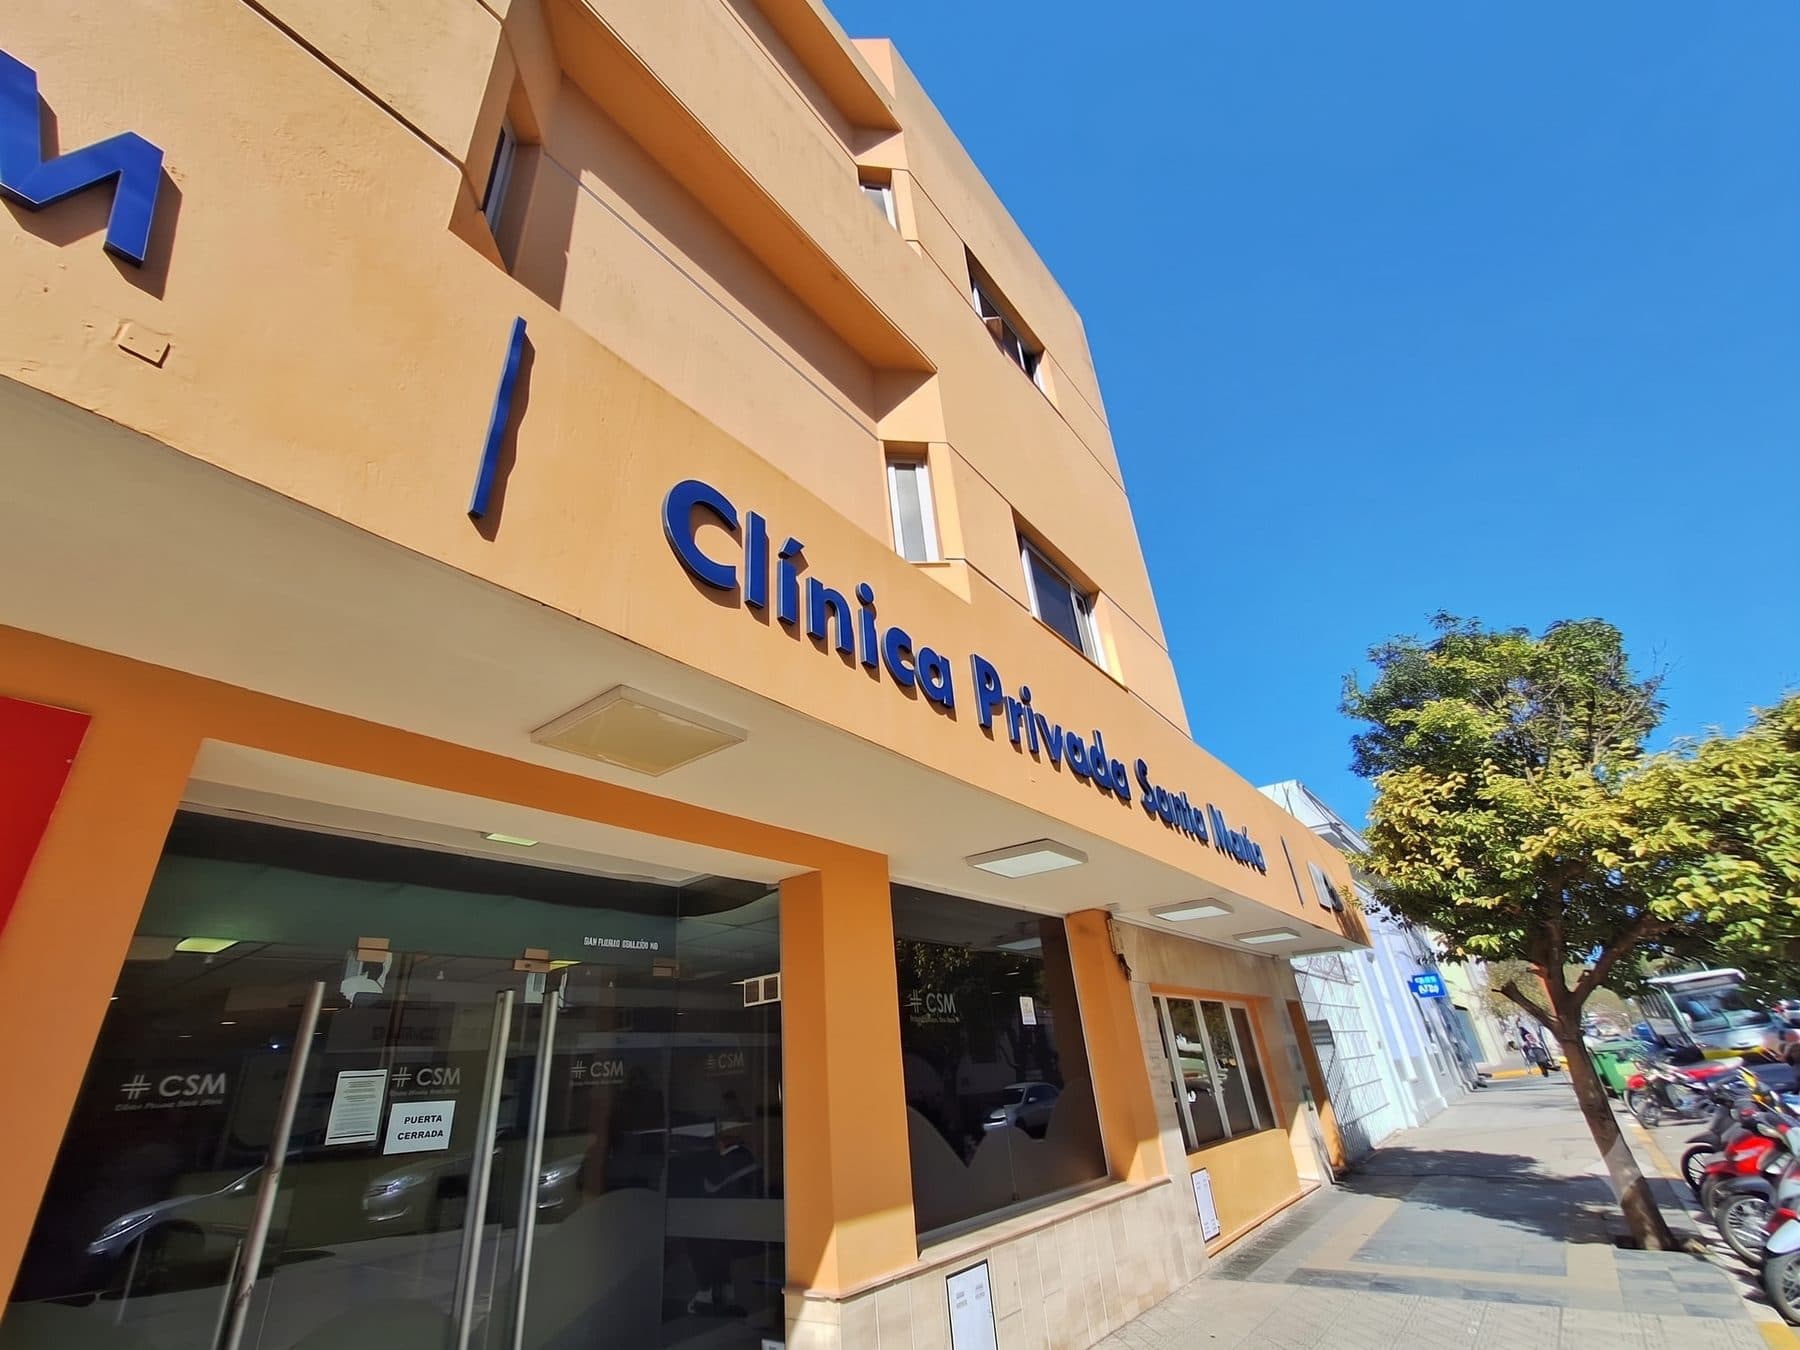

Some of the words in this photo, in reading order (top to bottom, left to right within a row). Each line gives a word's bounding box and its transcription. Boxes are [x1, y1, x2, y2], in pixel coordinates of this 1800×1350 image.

[661, 479, 954, 708] Clínica
[970, 653, 1132, 801] Privada
[1134, 758, 1209, 842] Santa
[416, 1067, 461, 1086] CSM
[590, 1061, 624, 1078] CSM
[158, 1072, 226, 1097] CSM
[404, 1114, 443, 1125] PUERTA
[397, 1129, 444, 1141] CERRADA
